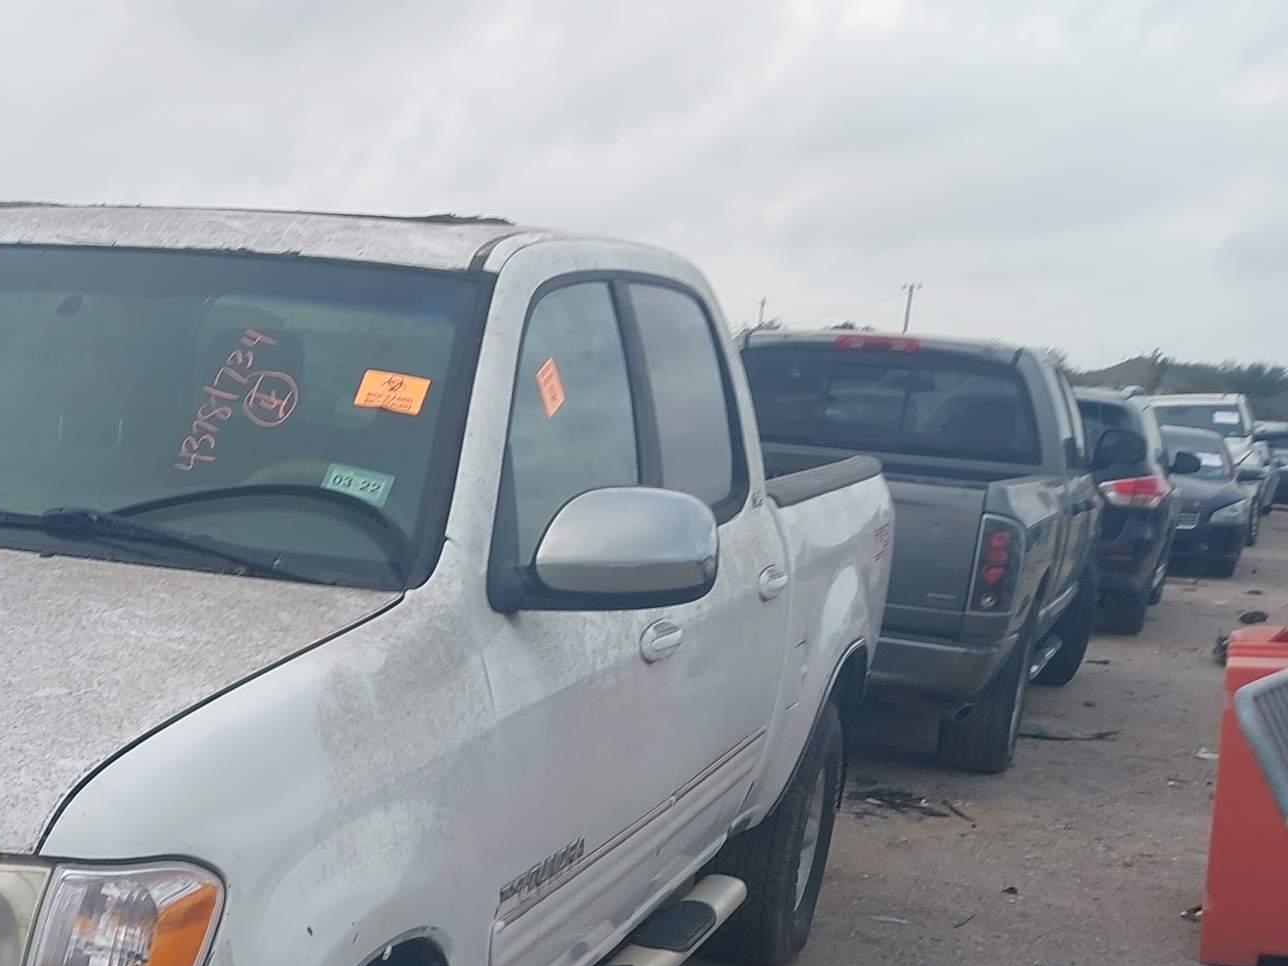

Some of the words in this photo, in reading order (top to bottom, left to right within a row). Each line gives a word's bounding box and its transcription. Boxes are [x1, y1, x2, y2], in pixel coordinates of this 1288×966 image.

[174, 328, 279, 471] 43781734
[332, 474, 353, 488] 03
[359, 479, 381, 493] 22
